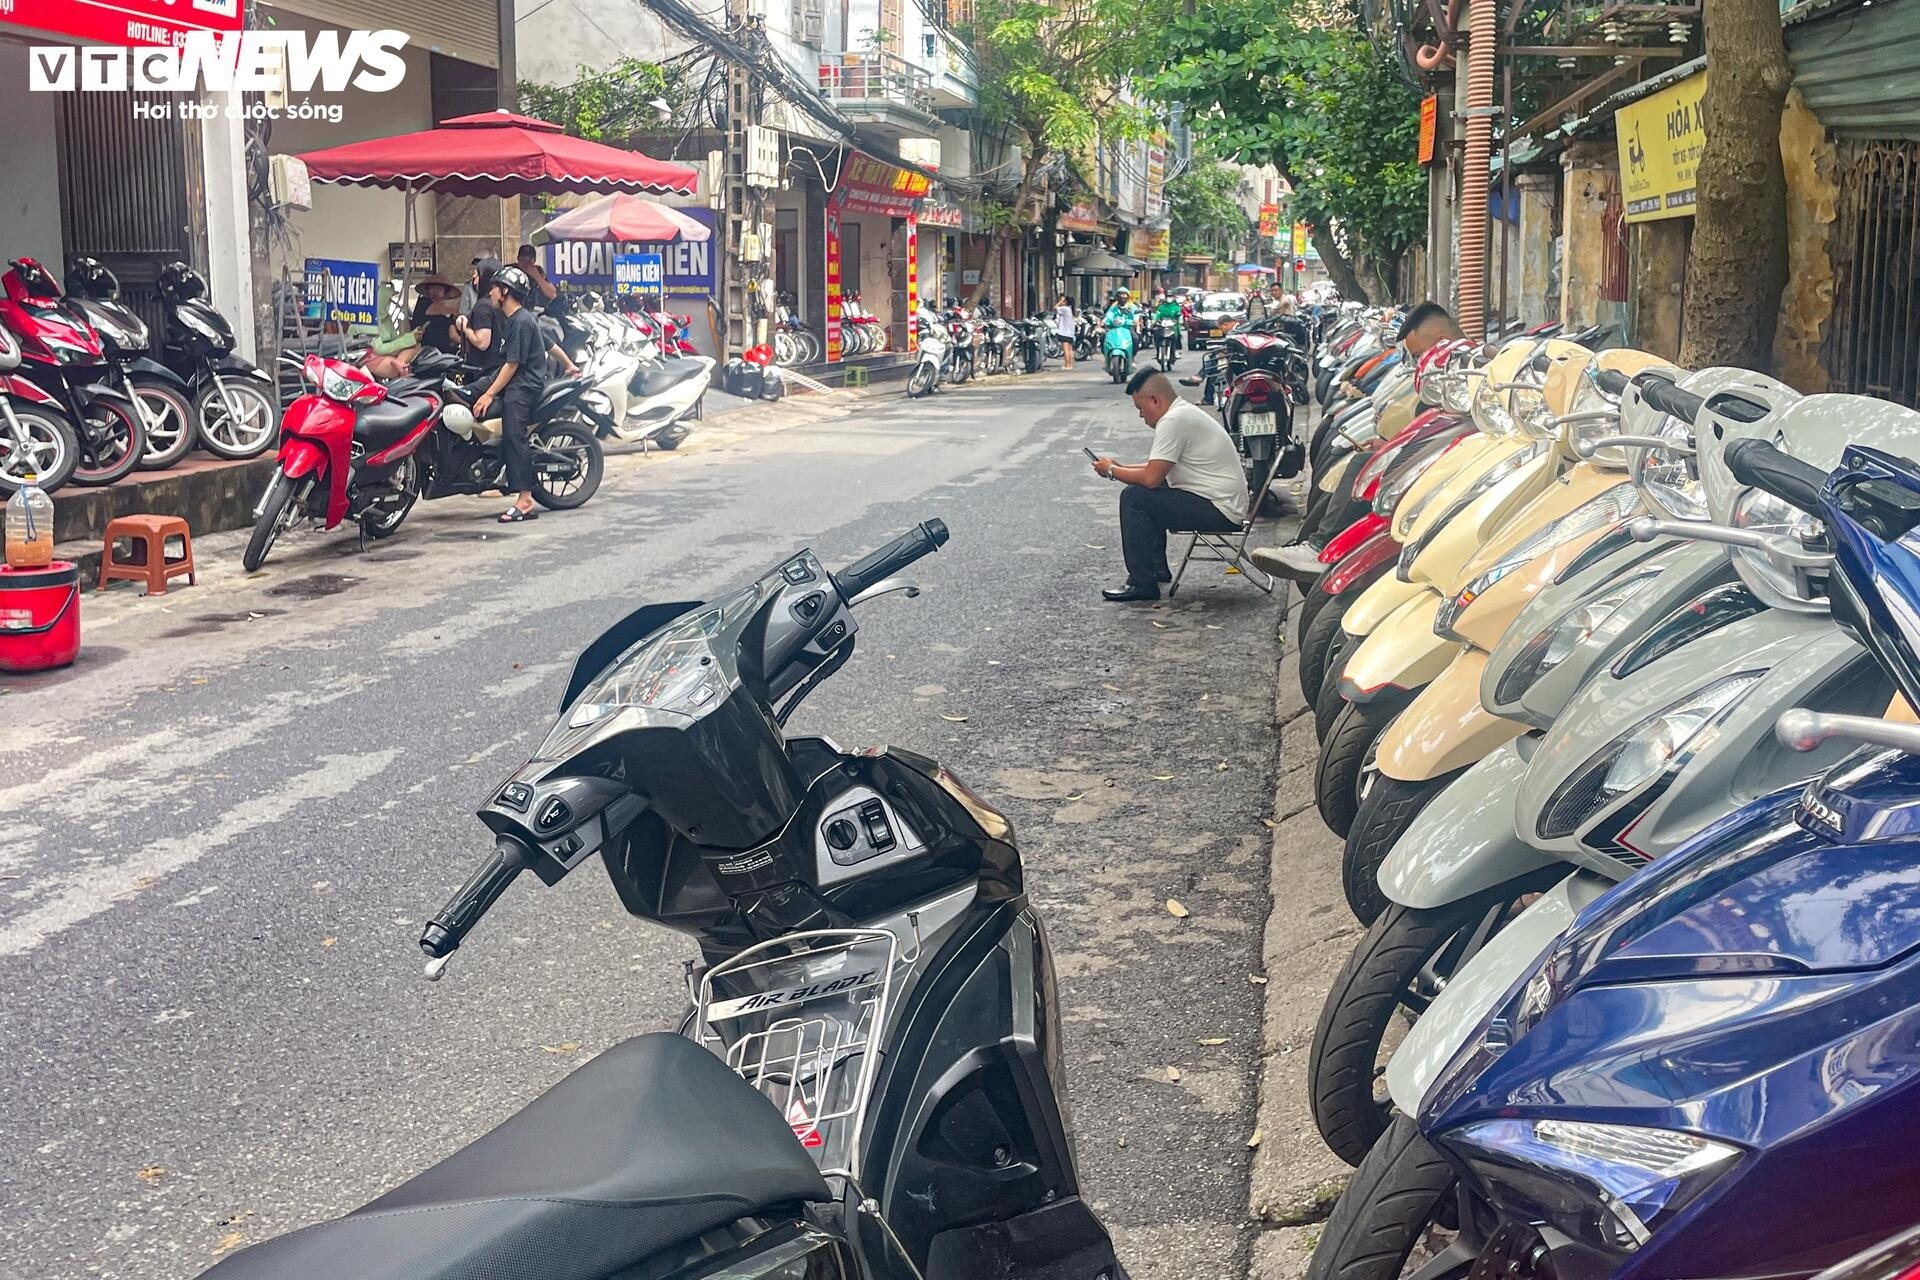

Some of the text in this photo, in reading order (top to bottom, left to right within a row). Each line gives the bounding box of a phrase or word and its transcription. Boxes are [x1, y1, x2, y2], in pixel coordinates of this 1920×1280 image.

[127, 20, 171, 46] HOTLINE:
[1667, 99, 1691, 141] HÒA
[616, 261, 641, 283] HOÀNG
[347, 271, 375, 307] KIÊN
[358, 311, 373, 324] Hà
[735, 993, 785, 1012] AIR
